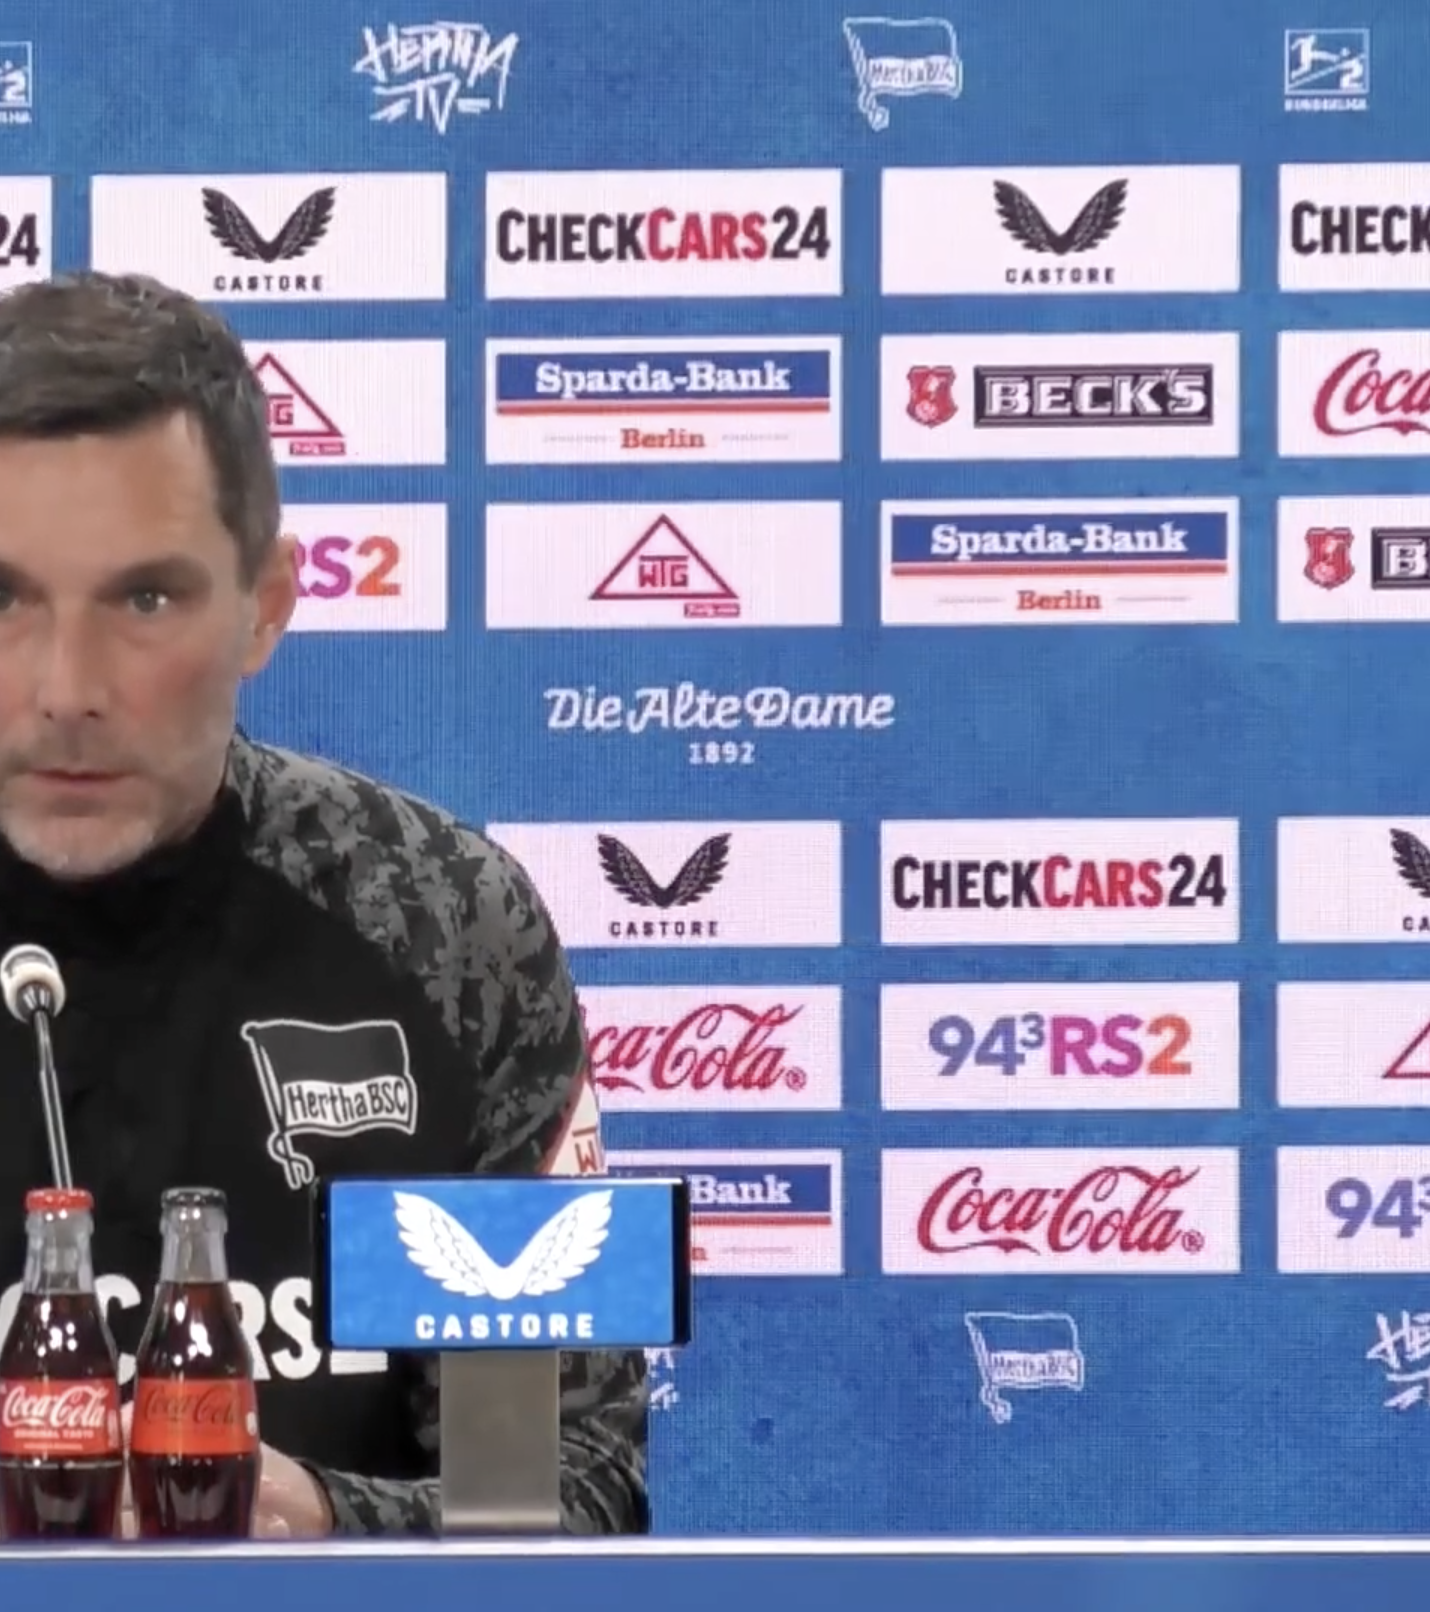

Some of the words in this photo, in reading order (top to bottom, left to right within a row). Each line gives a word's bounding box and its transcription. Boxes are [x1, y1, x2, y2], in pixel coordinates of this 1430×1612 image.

[497, 206, 830, 263] CHECKCARS24
[214, 275, 321, 291] CASTORE
[1006, 268, 1114, 284] CASTORE
[535, 362, 791, 400] Sparda-Bank
[621, 428, 705, 449] Berlin
[930, 523, 1188, 561] Sparda-Bank
[638, 555, 689, 588] WTG
[1017, 590, 1101, 610] Berlin
[689, 741, 754, 764] 1892
[893, 853, 1227, 910] CHECKCARS24
[609, 921, 717, 937] CASTORE
[416, 1313, 593, 1339] CASTORE
